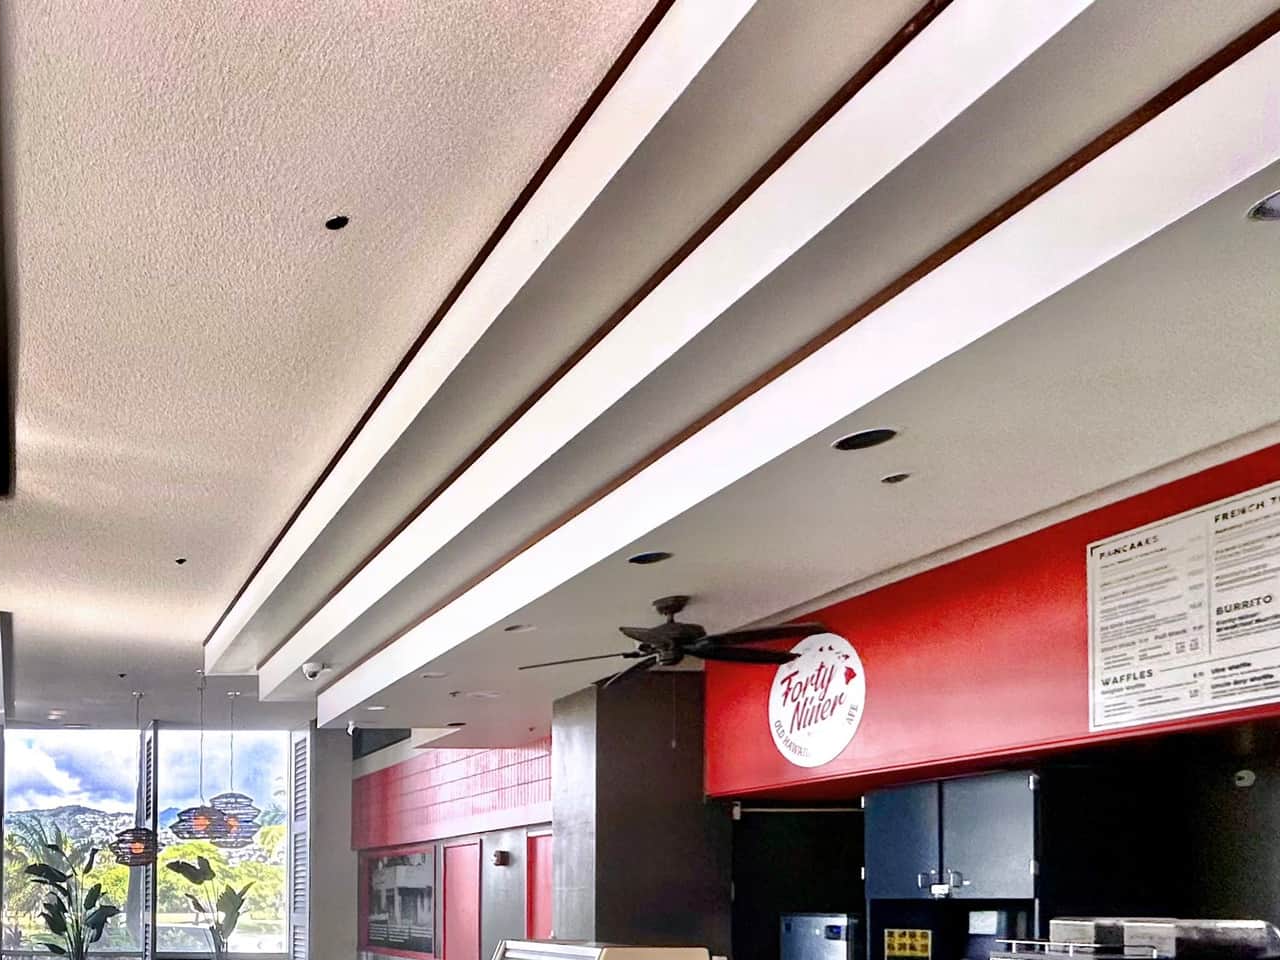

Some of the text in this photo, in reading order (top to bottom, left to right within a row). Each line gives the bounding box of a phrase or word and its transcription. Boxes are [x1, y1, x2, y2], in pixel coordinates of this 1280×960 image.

[1214, 501, 1265, 523] FRENCH
[1216, 594, 1273, 616] BURRITO
[780, 661, 836, 708] Forty
[1101, 669, 1153, 687] WAFFLES
[789, 691, 846, 735] Niner
